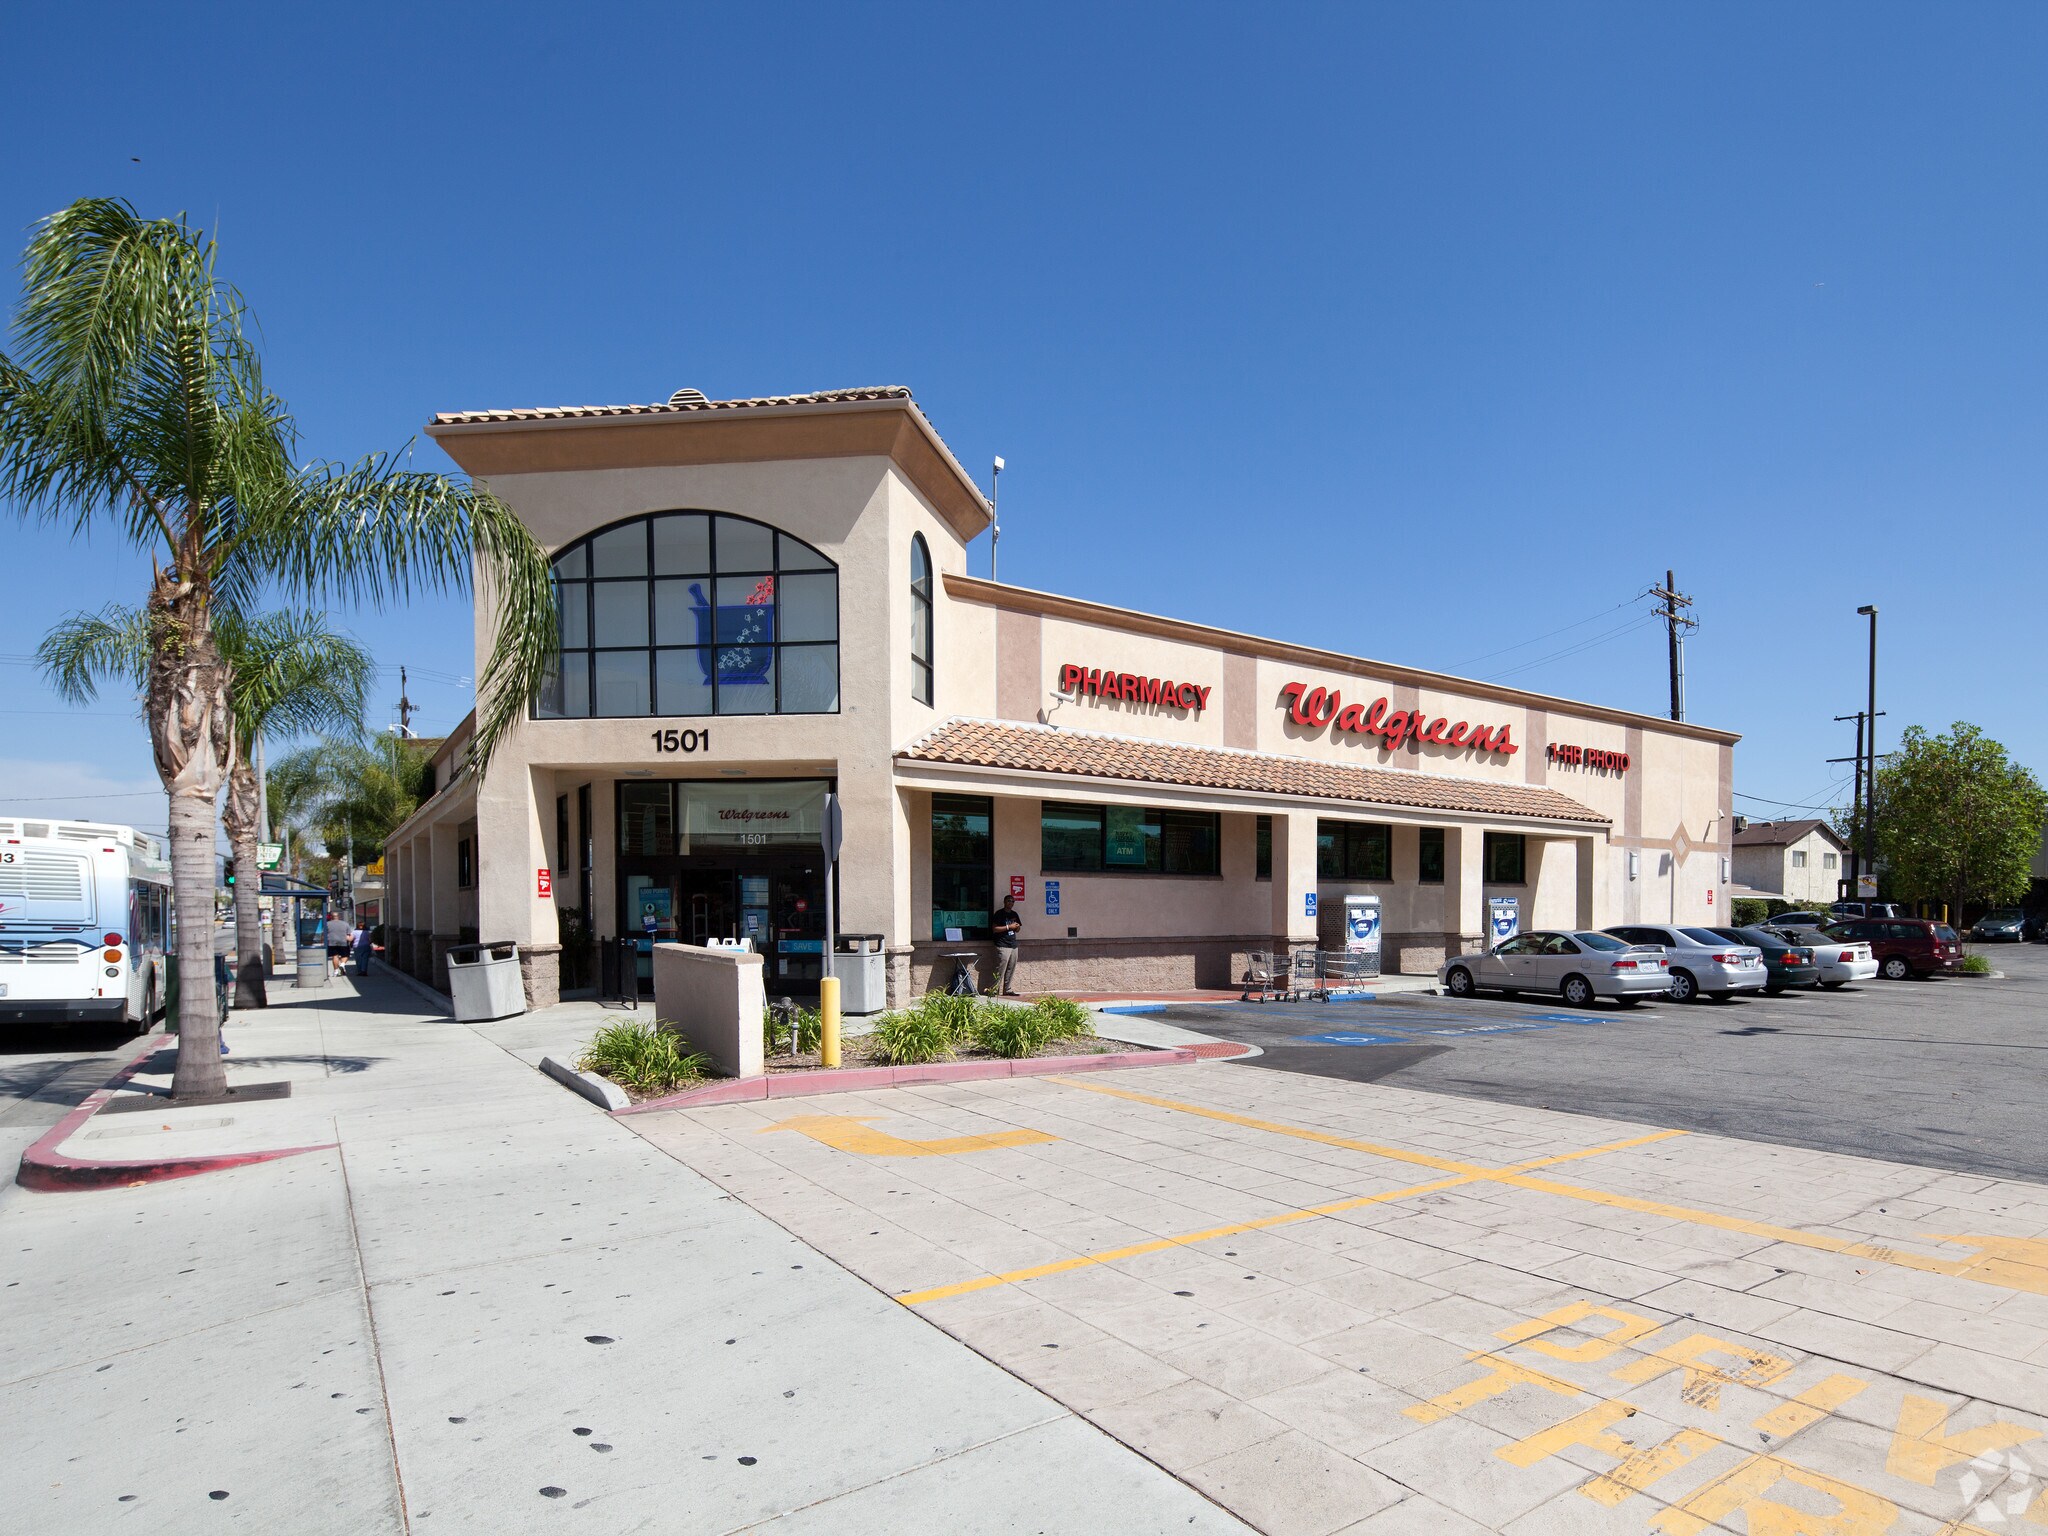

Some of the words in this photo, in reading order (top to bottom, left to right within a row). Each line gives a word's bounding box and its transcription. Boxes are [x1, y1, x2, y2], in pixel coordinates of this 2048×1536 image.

[1062, 663, 1212, 711] PHARMACY
[1283, 681, 1519, 752] Walgreens
[651, 729, 709, 753] 1501
[1549, 742, 1582, 765] 1-HR
[1586, 748, 1631, 772] PHOTO
[718, 808, 790, 823] Walgreens
[740, 834, 767, 845] 1501
[1116, 847, 1134, 855] ATM
[946, 913, 953, 923] A
[793, 942, 813, 951] SAVE
